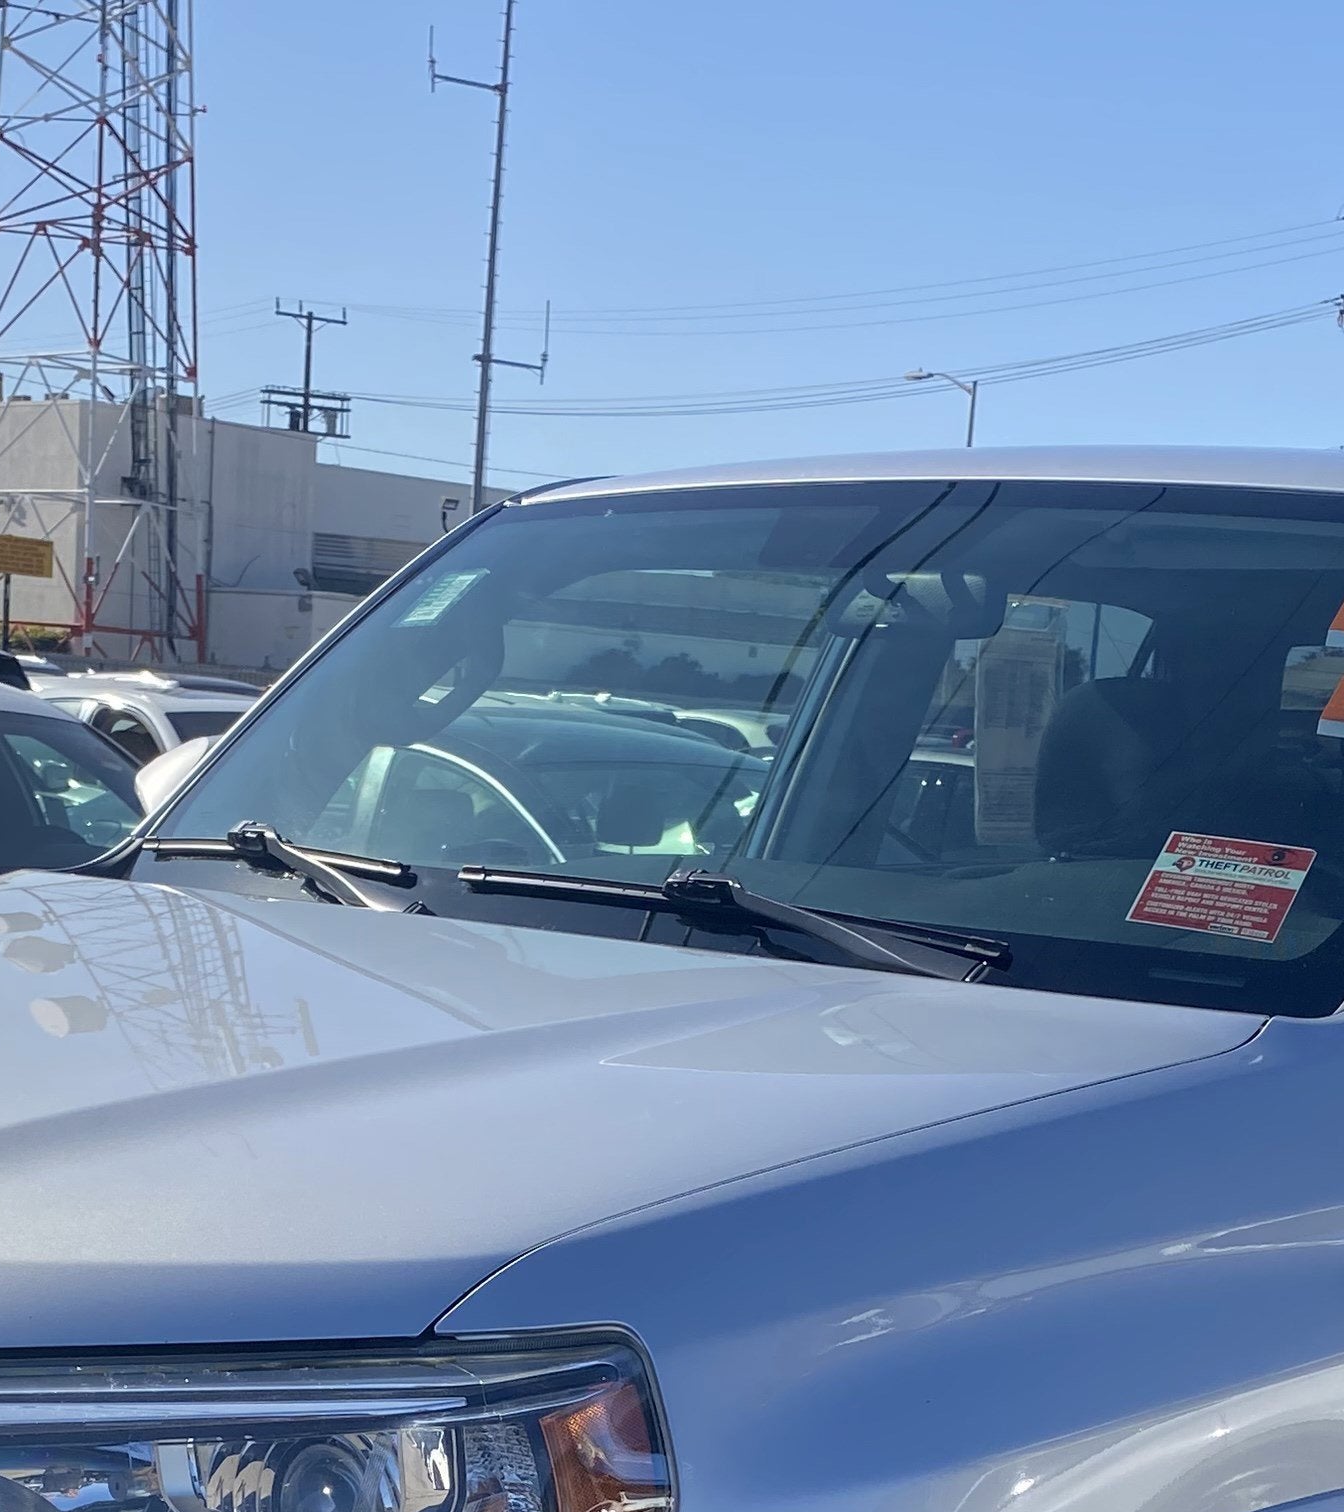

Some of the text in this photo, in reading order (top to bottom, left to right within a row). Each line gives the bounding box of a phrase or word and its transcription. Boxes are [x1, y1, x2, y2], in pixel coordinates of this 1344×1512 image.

[1178, 842, 1222, 852] Watching
[1175, 847, 1258, 863] New Investment?
